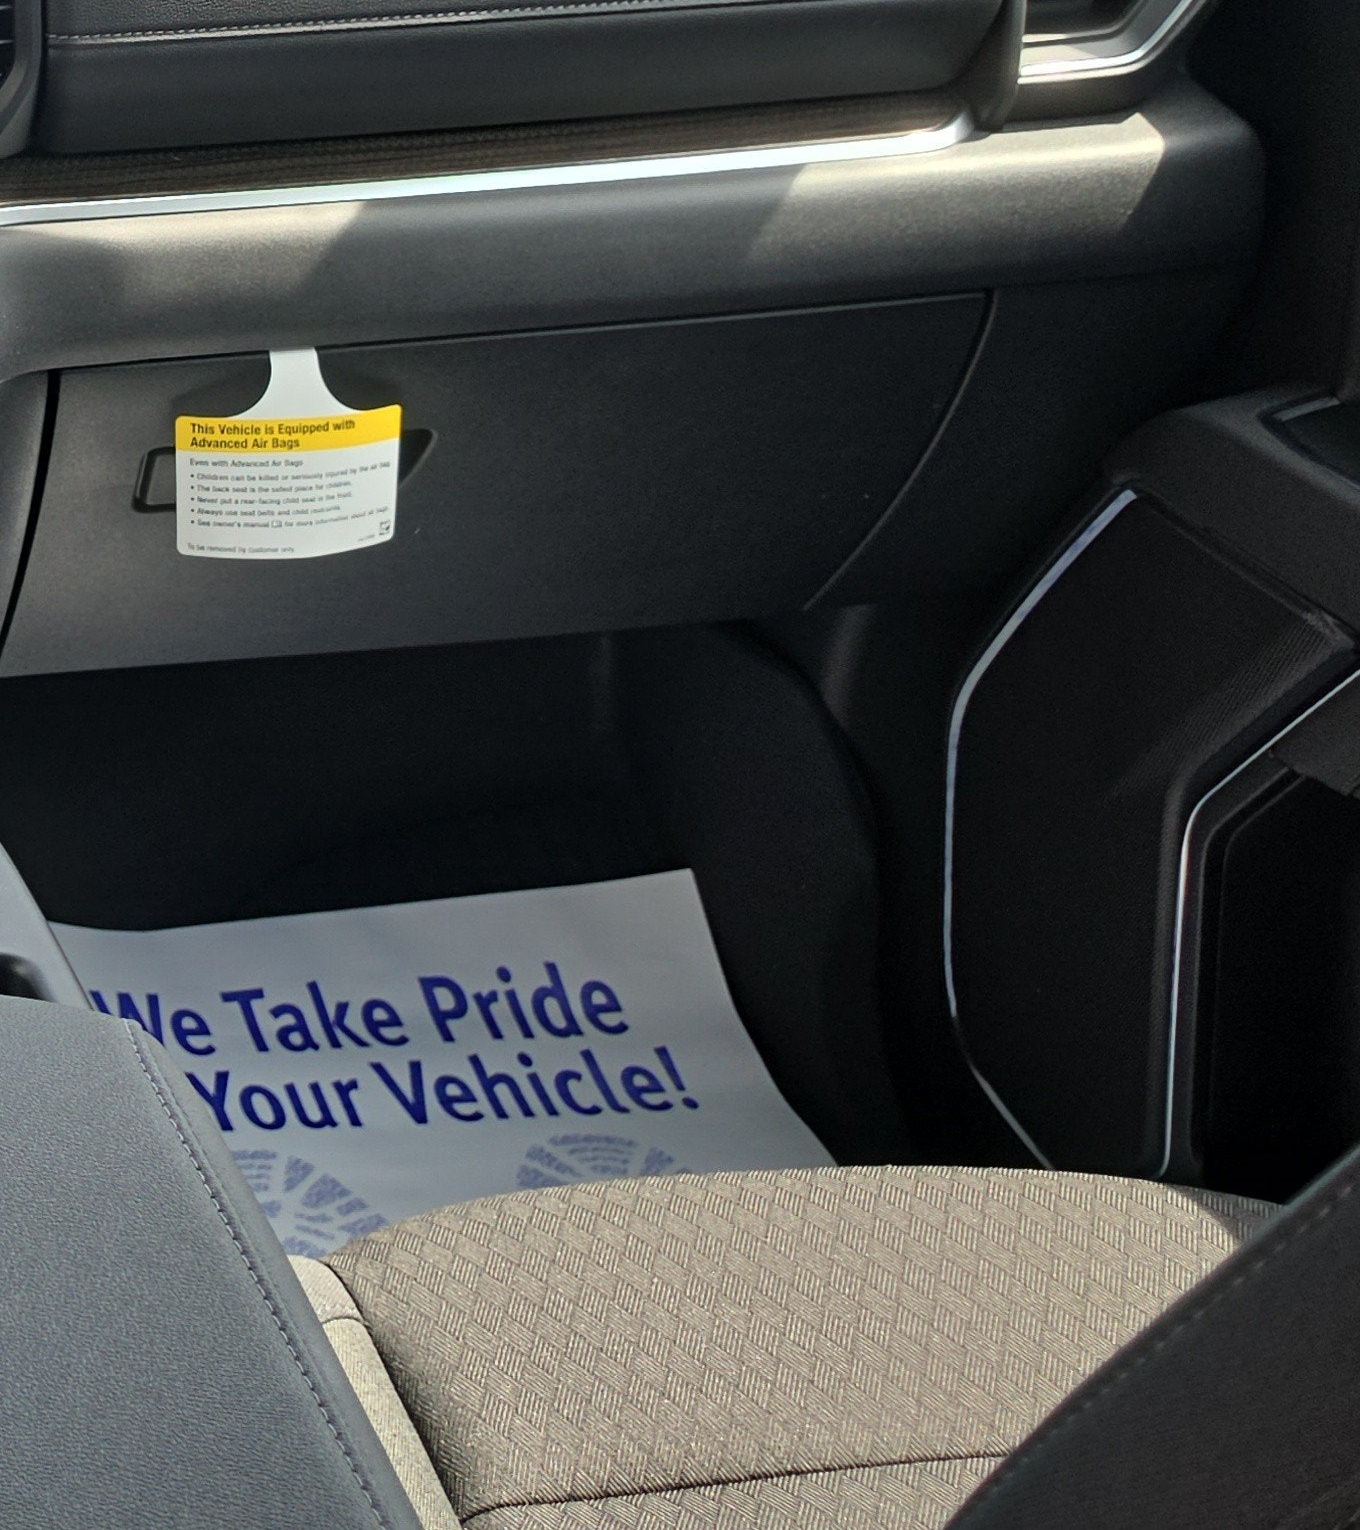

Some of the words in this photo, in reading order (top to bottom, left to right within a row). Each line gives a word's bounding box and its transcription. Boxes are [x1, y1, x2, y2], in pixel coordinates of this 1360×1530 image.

[190, 422, 215, 435] This
[218, 423, 261, 436] Vehicle
[264, 424, 275, 435] is
[277, 421, 330, 436] Equipped
[332, 418, 356, 431] with
[190, 436, 248, 449] Advanced
[251, 438, 268, 449] Air
[271, 437, 300, 450] Bags
[189, 457, 209, 467] Even
[211, 459, 228, 467] with
[230, 459, 270, 467] Advanced
[284, 459, 304, 468] Bags
[90, 989, 216, 1057] We
[220, 980, 409, 1055] Take
[418, 961, 631, 1044] Pride
[184, 1069, 361, 1134] Your
[369, 1045, 700, 1126] Vehicle!
